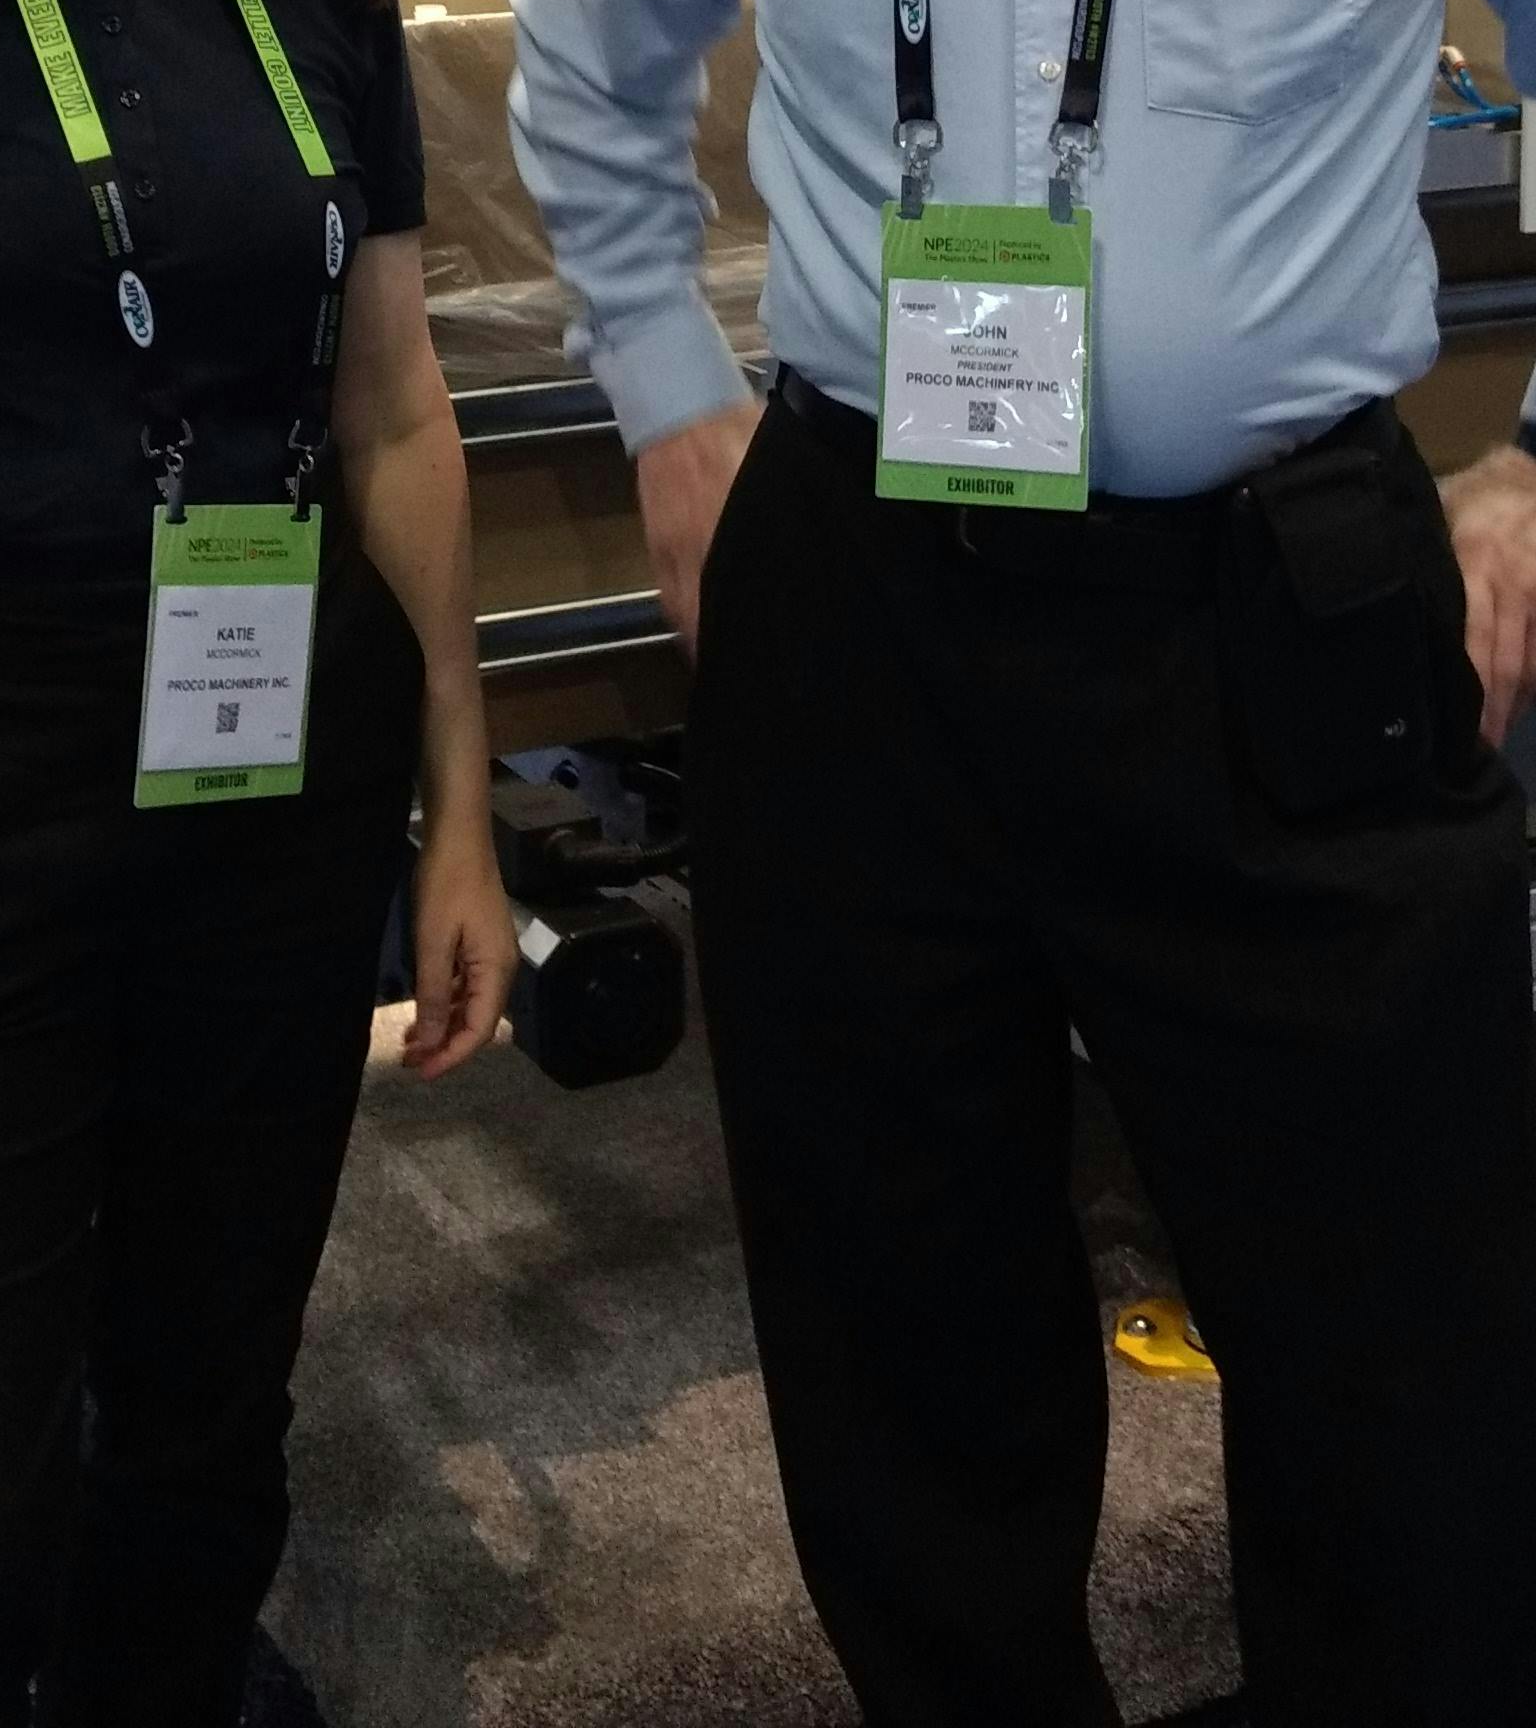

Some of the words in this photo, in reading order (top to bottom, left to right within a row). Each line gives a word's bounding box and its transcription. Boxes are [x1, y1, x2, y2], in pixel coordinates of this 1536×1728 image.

[43, 51, 92, 120] MAKE
[267, 58, 315, 134] COUNT
[950, 345, 1019, 359] MCCORMICK
[957, 359, 1013, 373] PRESIDENT
[905, 372, 953, 387] PROCO
[955, 376, 1033, 392] MACHINERY
[947, 477, 1014, 497] EXHIBITOR
[217, 627, 255, 642] KATIE
[167, 678, 206, 692] PROCO
[207, 677, 270, 691] MACHINERY
[194, 772, 248, 792] EXHIBITOR
